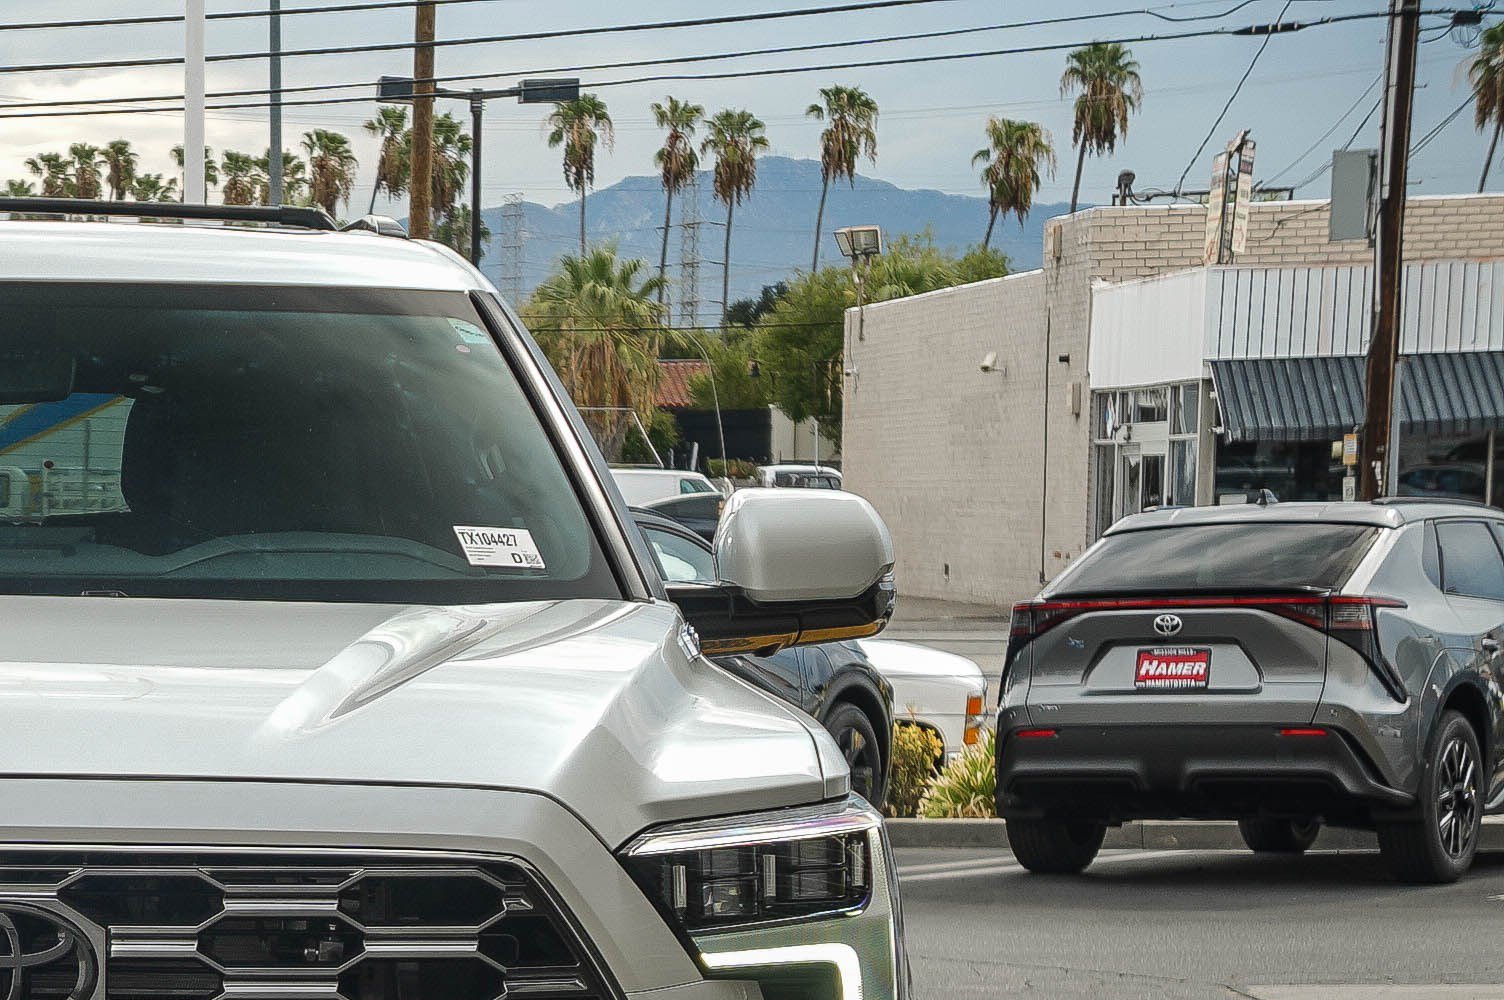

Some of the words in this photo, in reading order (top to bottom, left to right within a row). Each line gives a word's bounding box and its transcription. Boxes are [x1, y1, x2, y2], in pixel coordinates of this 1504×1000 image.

[458, 531, 517, 546] TX104427
[511, 552, 523, 563] D
[1139, 660, 1207, 676] HAMER
